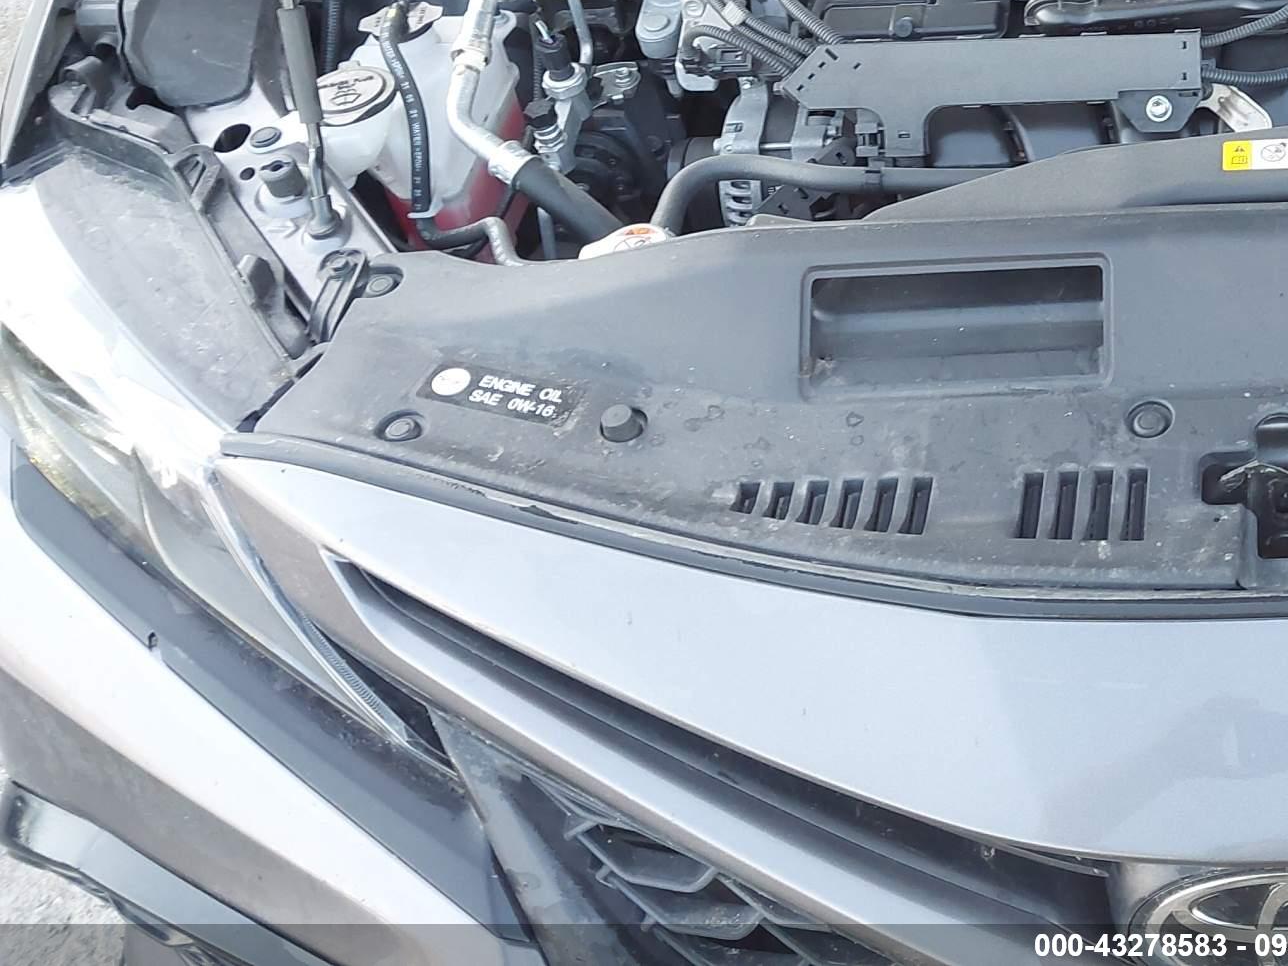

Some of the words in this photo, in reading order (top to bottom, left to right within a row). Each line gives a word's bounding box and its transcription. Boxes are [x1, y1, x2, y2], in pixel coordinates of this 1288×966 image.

[469, 389, 503, 406] SAE
[507, 397, 554, 417] 0W-16
[478, 375, 536, 396] ENGINE
[539, 387, 562, 403] OIL
